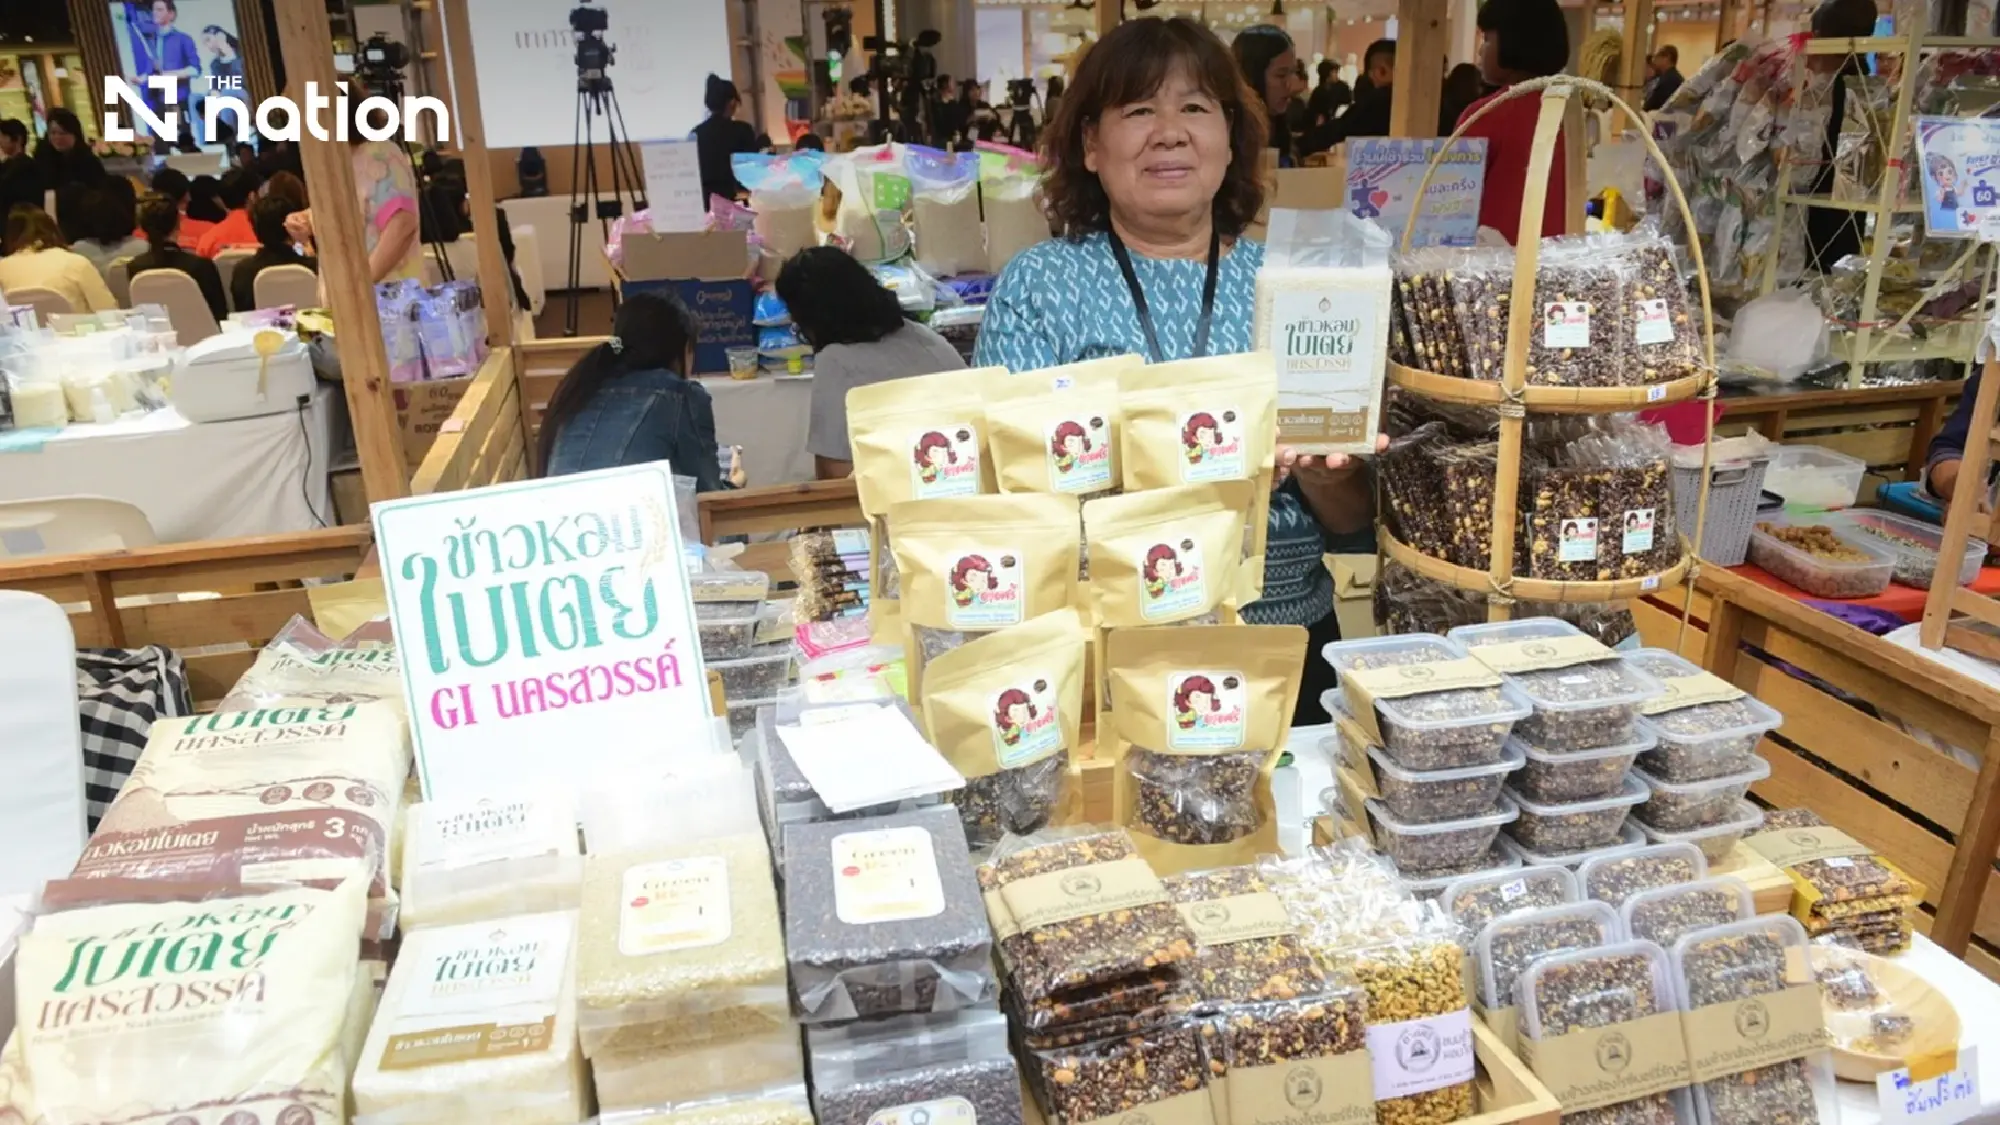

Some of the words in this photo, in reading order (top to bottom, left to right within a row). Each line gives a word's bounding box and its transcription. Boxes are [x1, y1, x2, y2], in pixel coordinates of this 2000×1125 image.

[1285, 322, 1354, 356] ใบเตย
[443, 505, 643, 579] ข้าวหอม
[402, 552, 659, 675] ใบเตย
[430, 683, 479, 730] GI
[491, 638, 683, 719] นครสวรรค์
[323, 816, 346, 839] 3
[52, 928, 280, 993] ใบเตย
[36, 961, 267, 1031] นครสวรรค์
